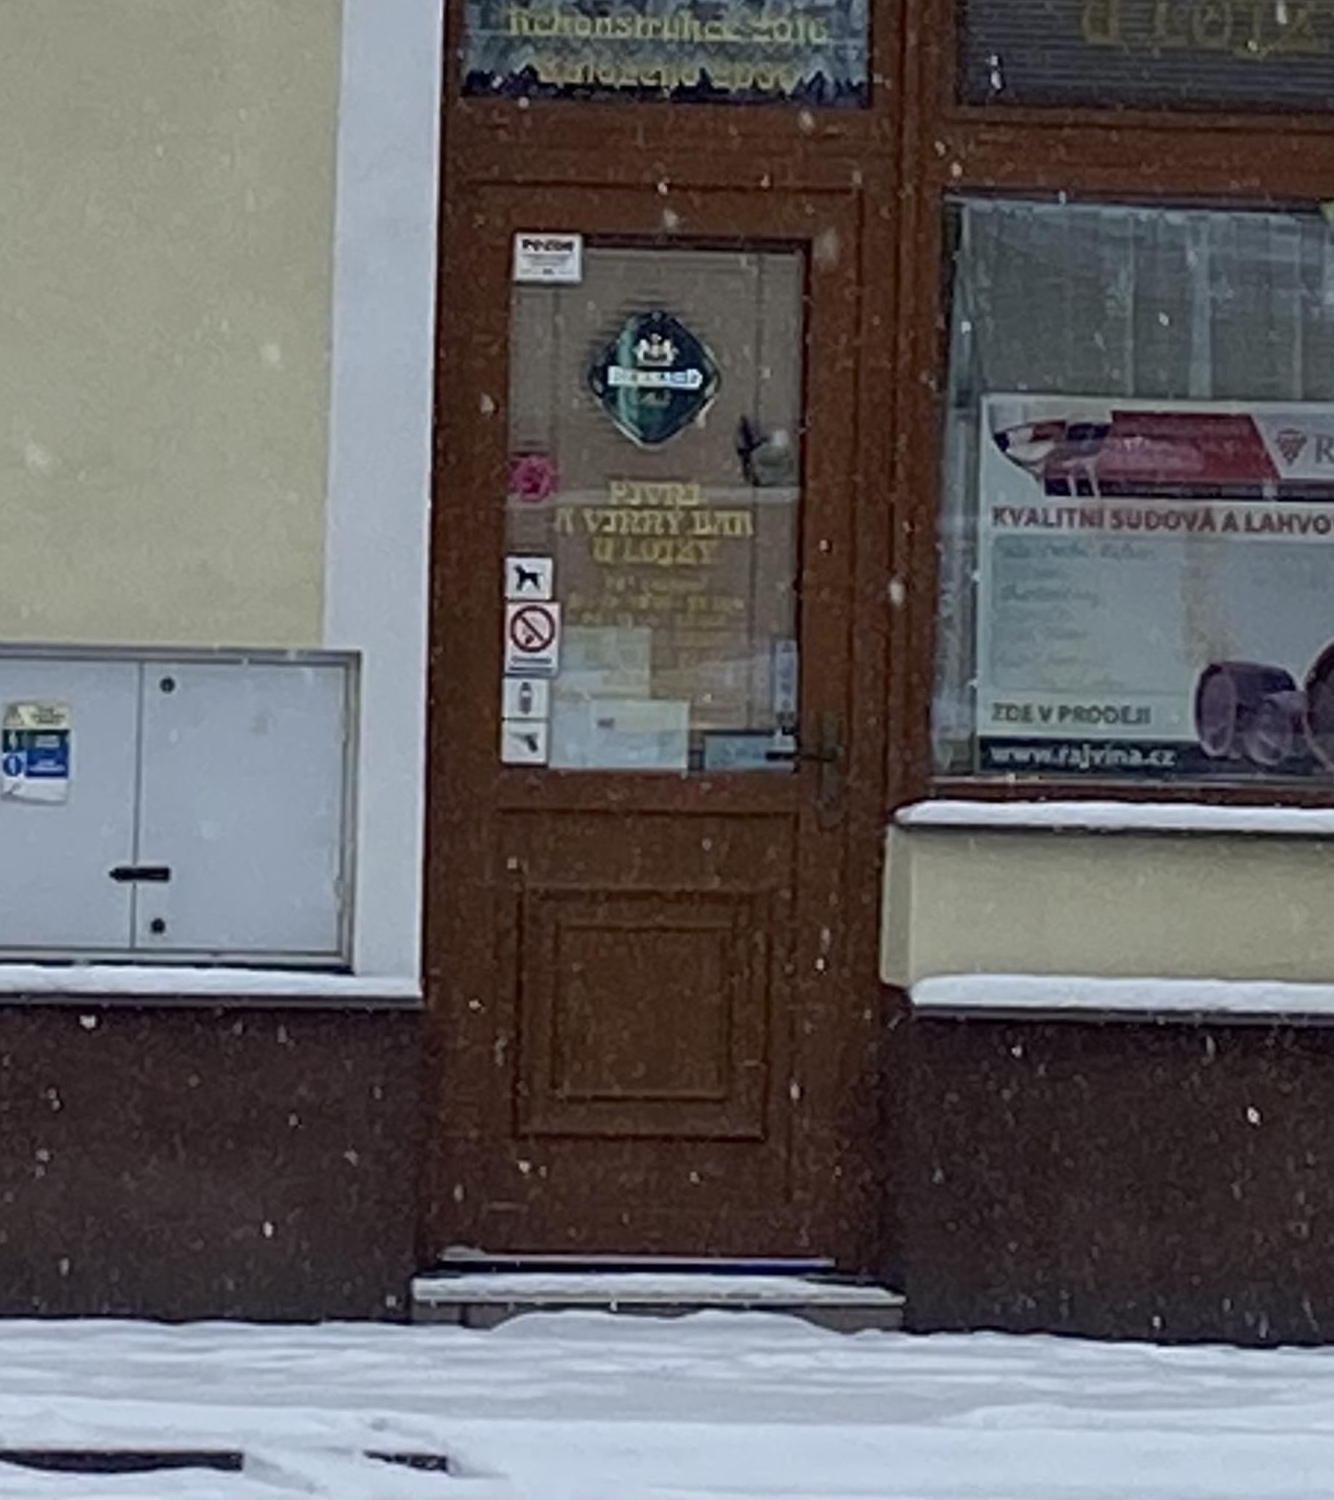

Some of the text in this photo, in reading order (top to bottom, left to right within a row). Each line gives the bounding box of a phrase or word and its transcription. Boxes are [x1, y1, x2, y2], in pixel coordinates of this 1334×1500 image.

[1110, 505, 1217, 532] SUDOVÁ
[1221, 510, 1240, 532] A
[991, 702, 1034, 723] ZDE
[1038, 705, 1054, 724] V
